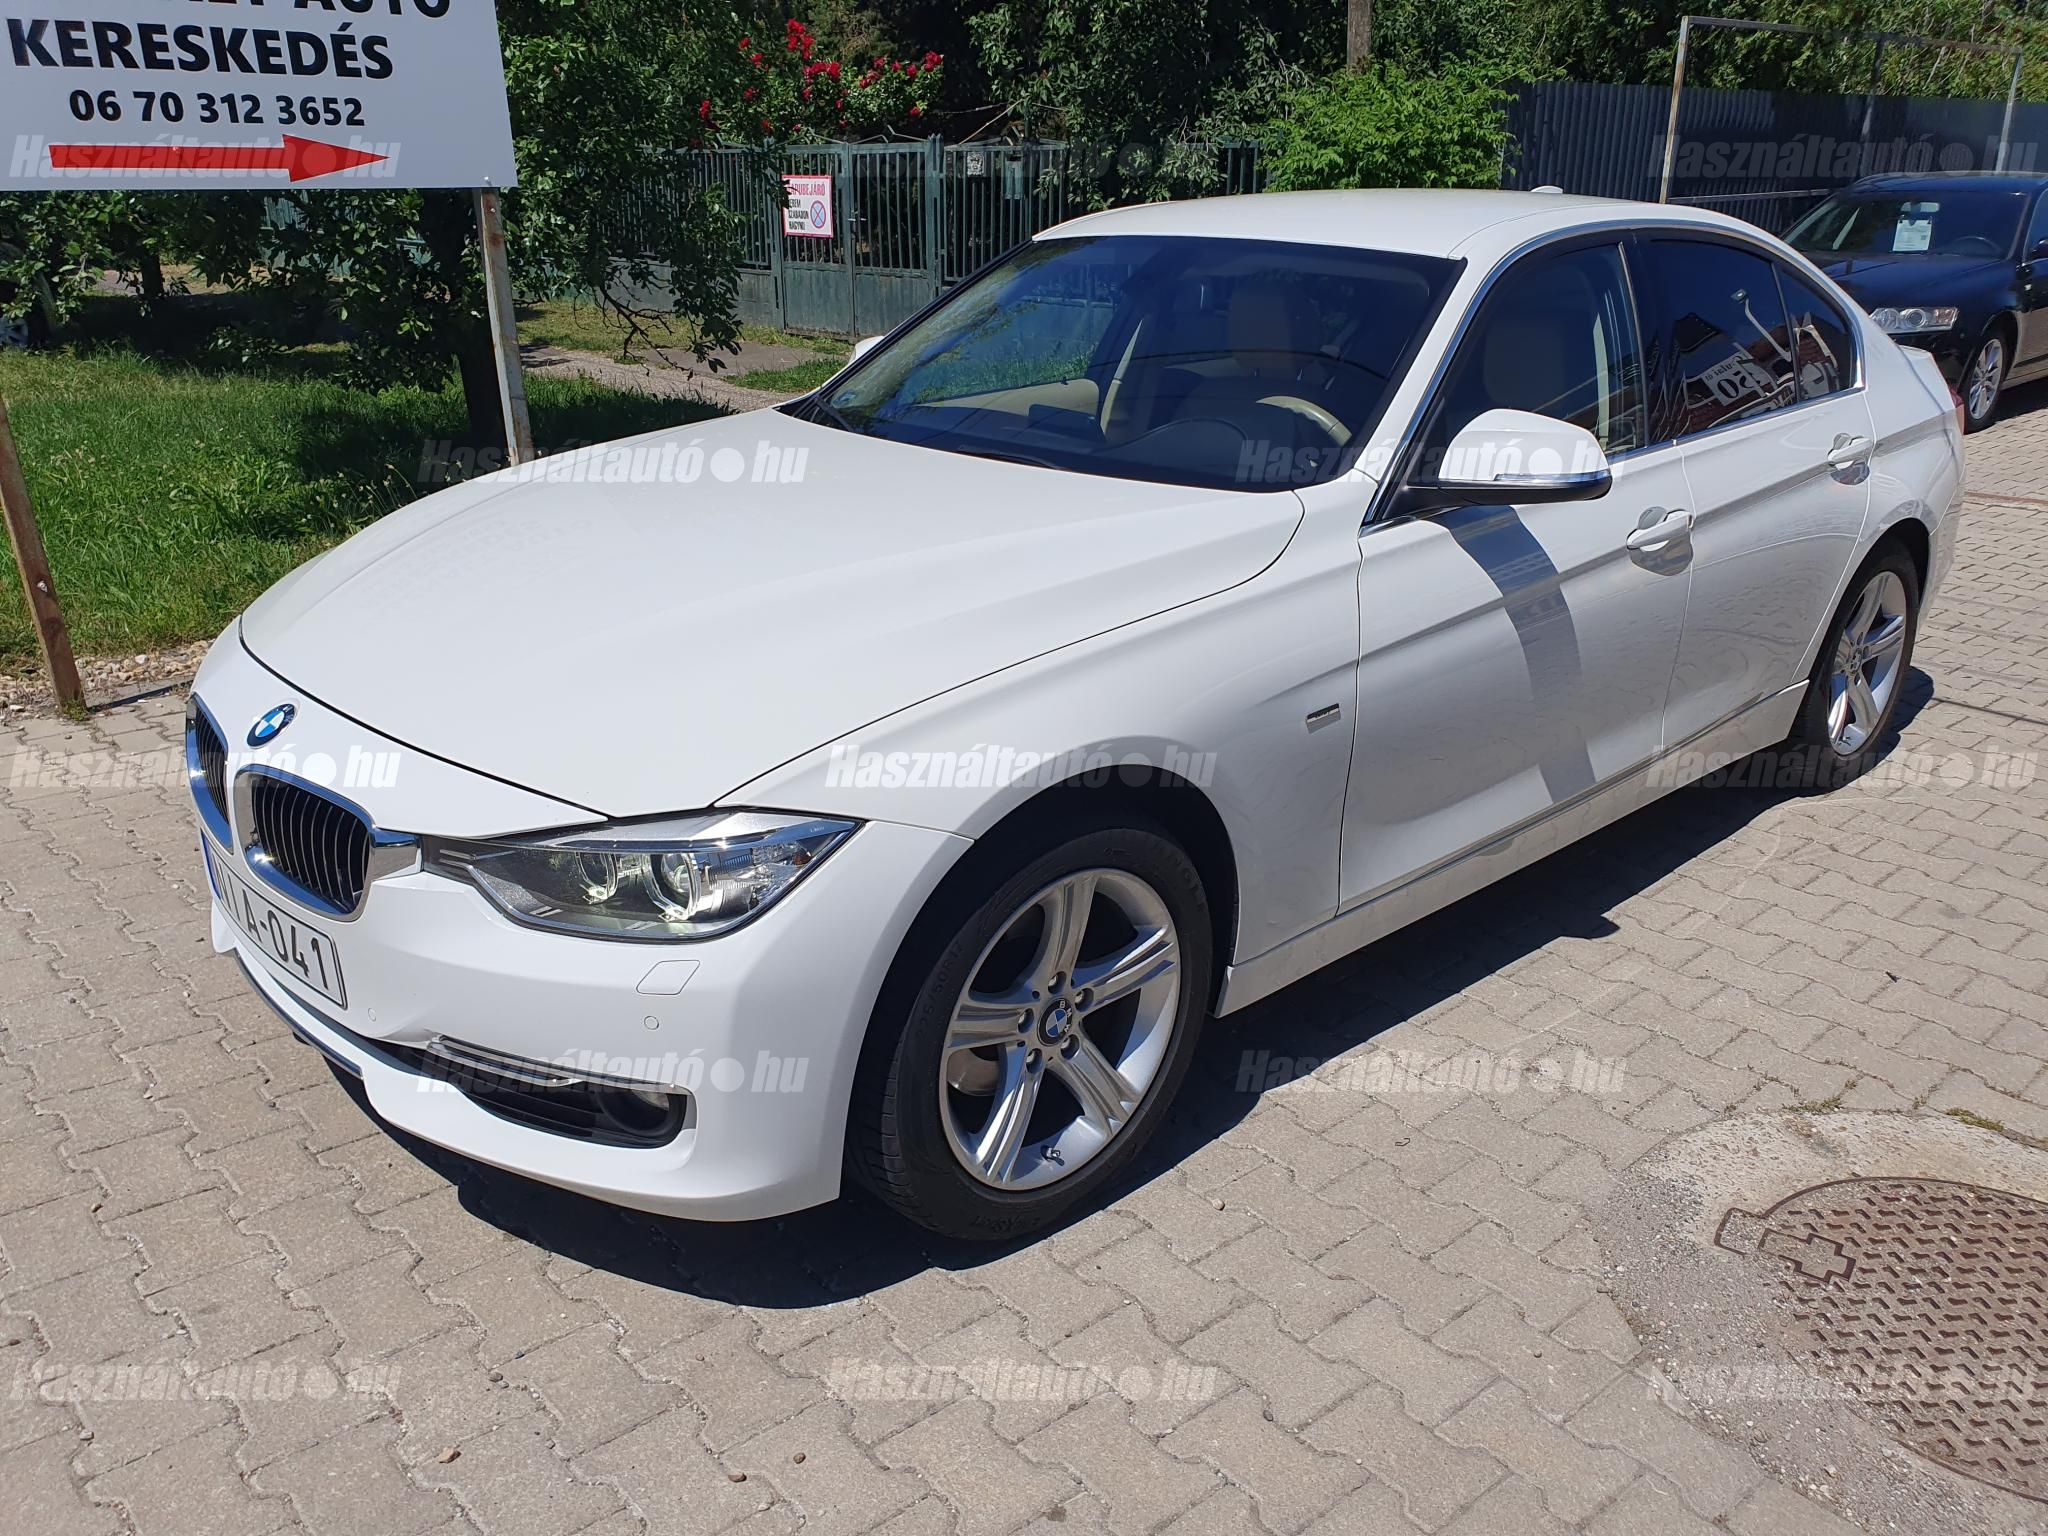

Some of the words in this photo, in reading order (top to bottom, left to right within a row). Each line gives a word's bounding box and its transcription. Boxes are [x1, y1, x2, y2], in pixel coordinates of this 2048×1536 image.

[7, 18, 394, 80] KERESKEDÉS
[69, 89, 122, 122] 06
[133, 91, 184, 123] 70
[197, 93, 264, 125] 312
[276, 95, 365, 127] 3652
